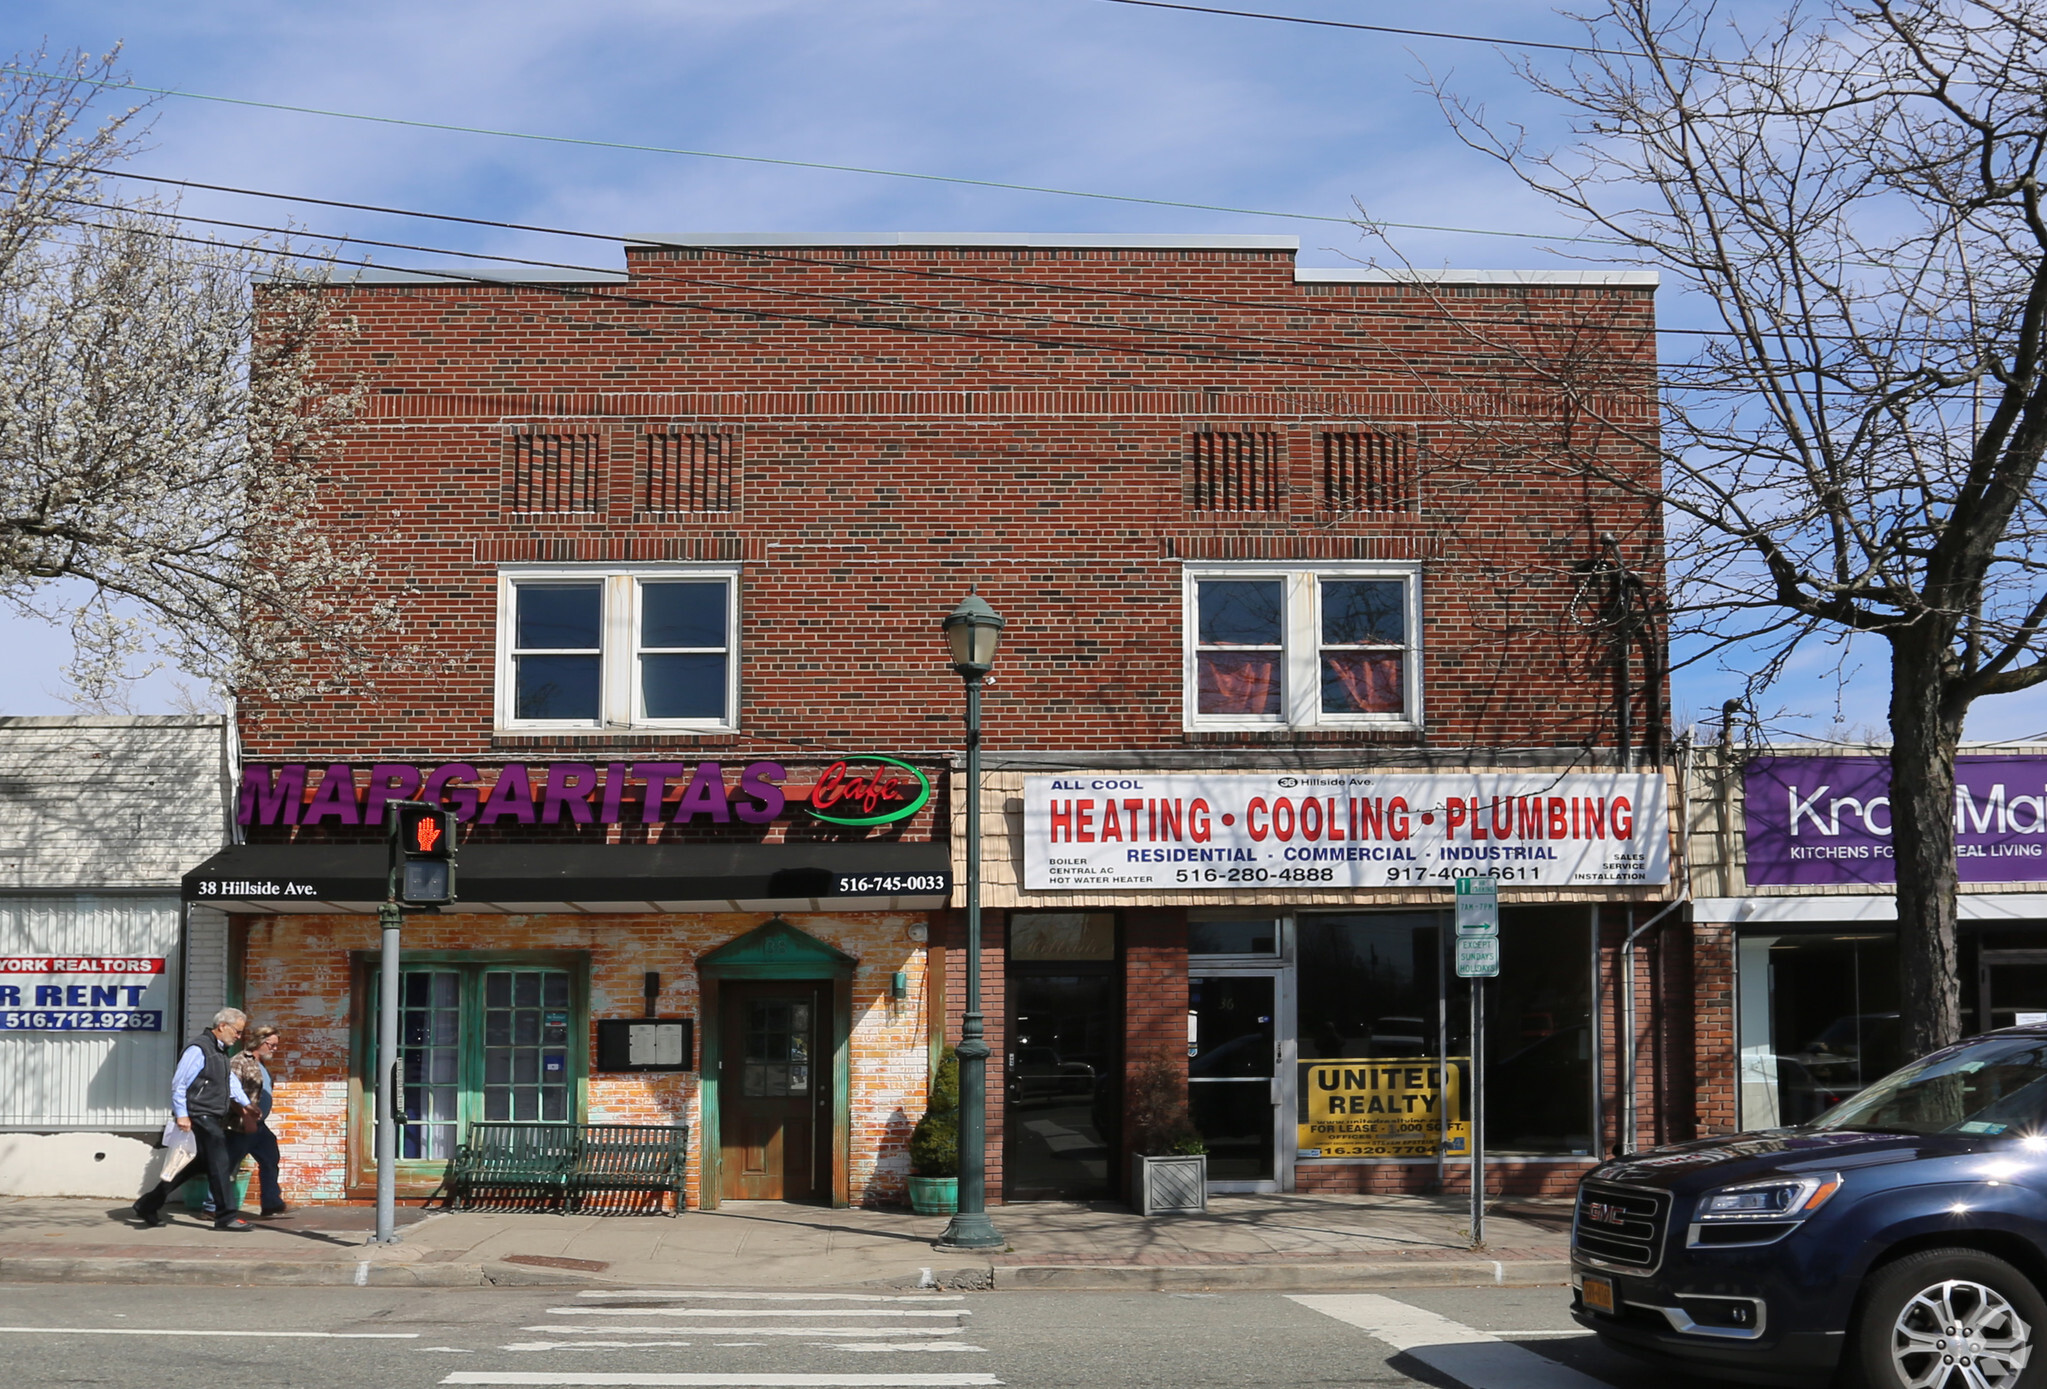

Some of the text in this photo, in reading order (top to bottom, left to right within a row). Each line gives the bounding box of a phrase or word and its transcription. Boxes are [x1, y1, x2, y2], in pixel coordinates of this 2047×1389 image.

[1051, 780, 1144, 790] ALL COOL
[1278, 777, 1375, 788] 36 Hillside Ave.
[237, 761, 787, 825] MARGARITAS
[1050, 796, 1633, 843] HEATING COOLING PLUMBING
[1127, 848, 1257, 862] RESIDENTIAL
[1284, 847, 1416, 861] COMMERCIAL
[1440, 846, 1557, 861] INDUSTRIAL
[1791, 844, 2042, 859] KITCHENS FO EAL LIVING
[1176, 868, 1334, 882] 516-280-4888
[1387, 867, 1540, 880] 917-400-6611
[198, 881, 317, 895] 38 Hillside Ave.
[839, 875, 944, 892] 516-745-0033
[1463, 941, 1491, 949] EXCEPT
[53, 959, 152, 971] REALTORS
[1460, 964, 1496, 972] HOLIDAYS
[35, 985, 147, 1007] RENT
[5, 1013, 155, 1028] 516.712.9262
[1318, 1068, 1449, 1091] UNITED
[1329, 1095, 1438, 1114] REALTY
[1310, 1124, 1335, 1133] FOR
[1339, 1124, 1378, 1133] LEASE
[1589, 1202, 1626, 1225] GMC
